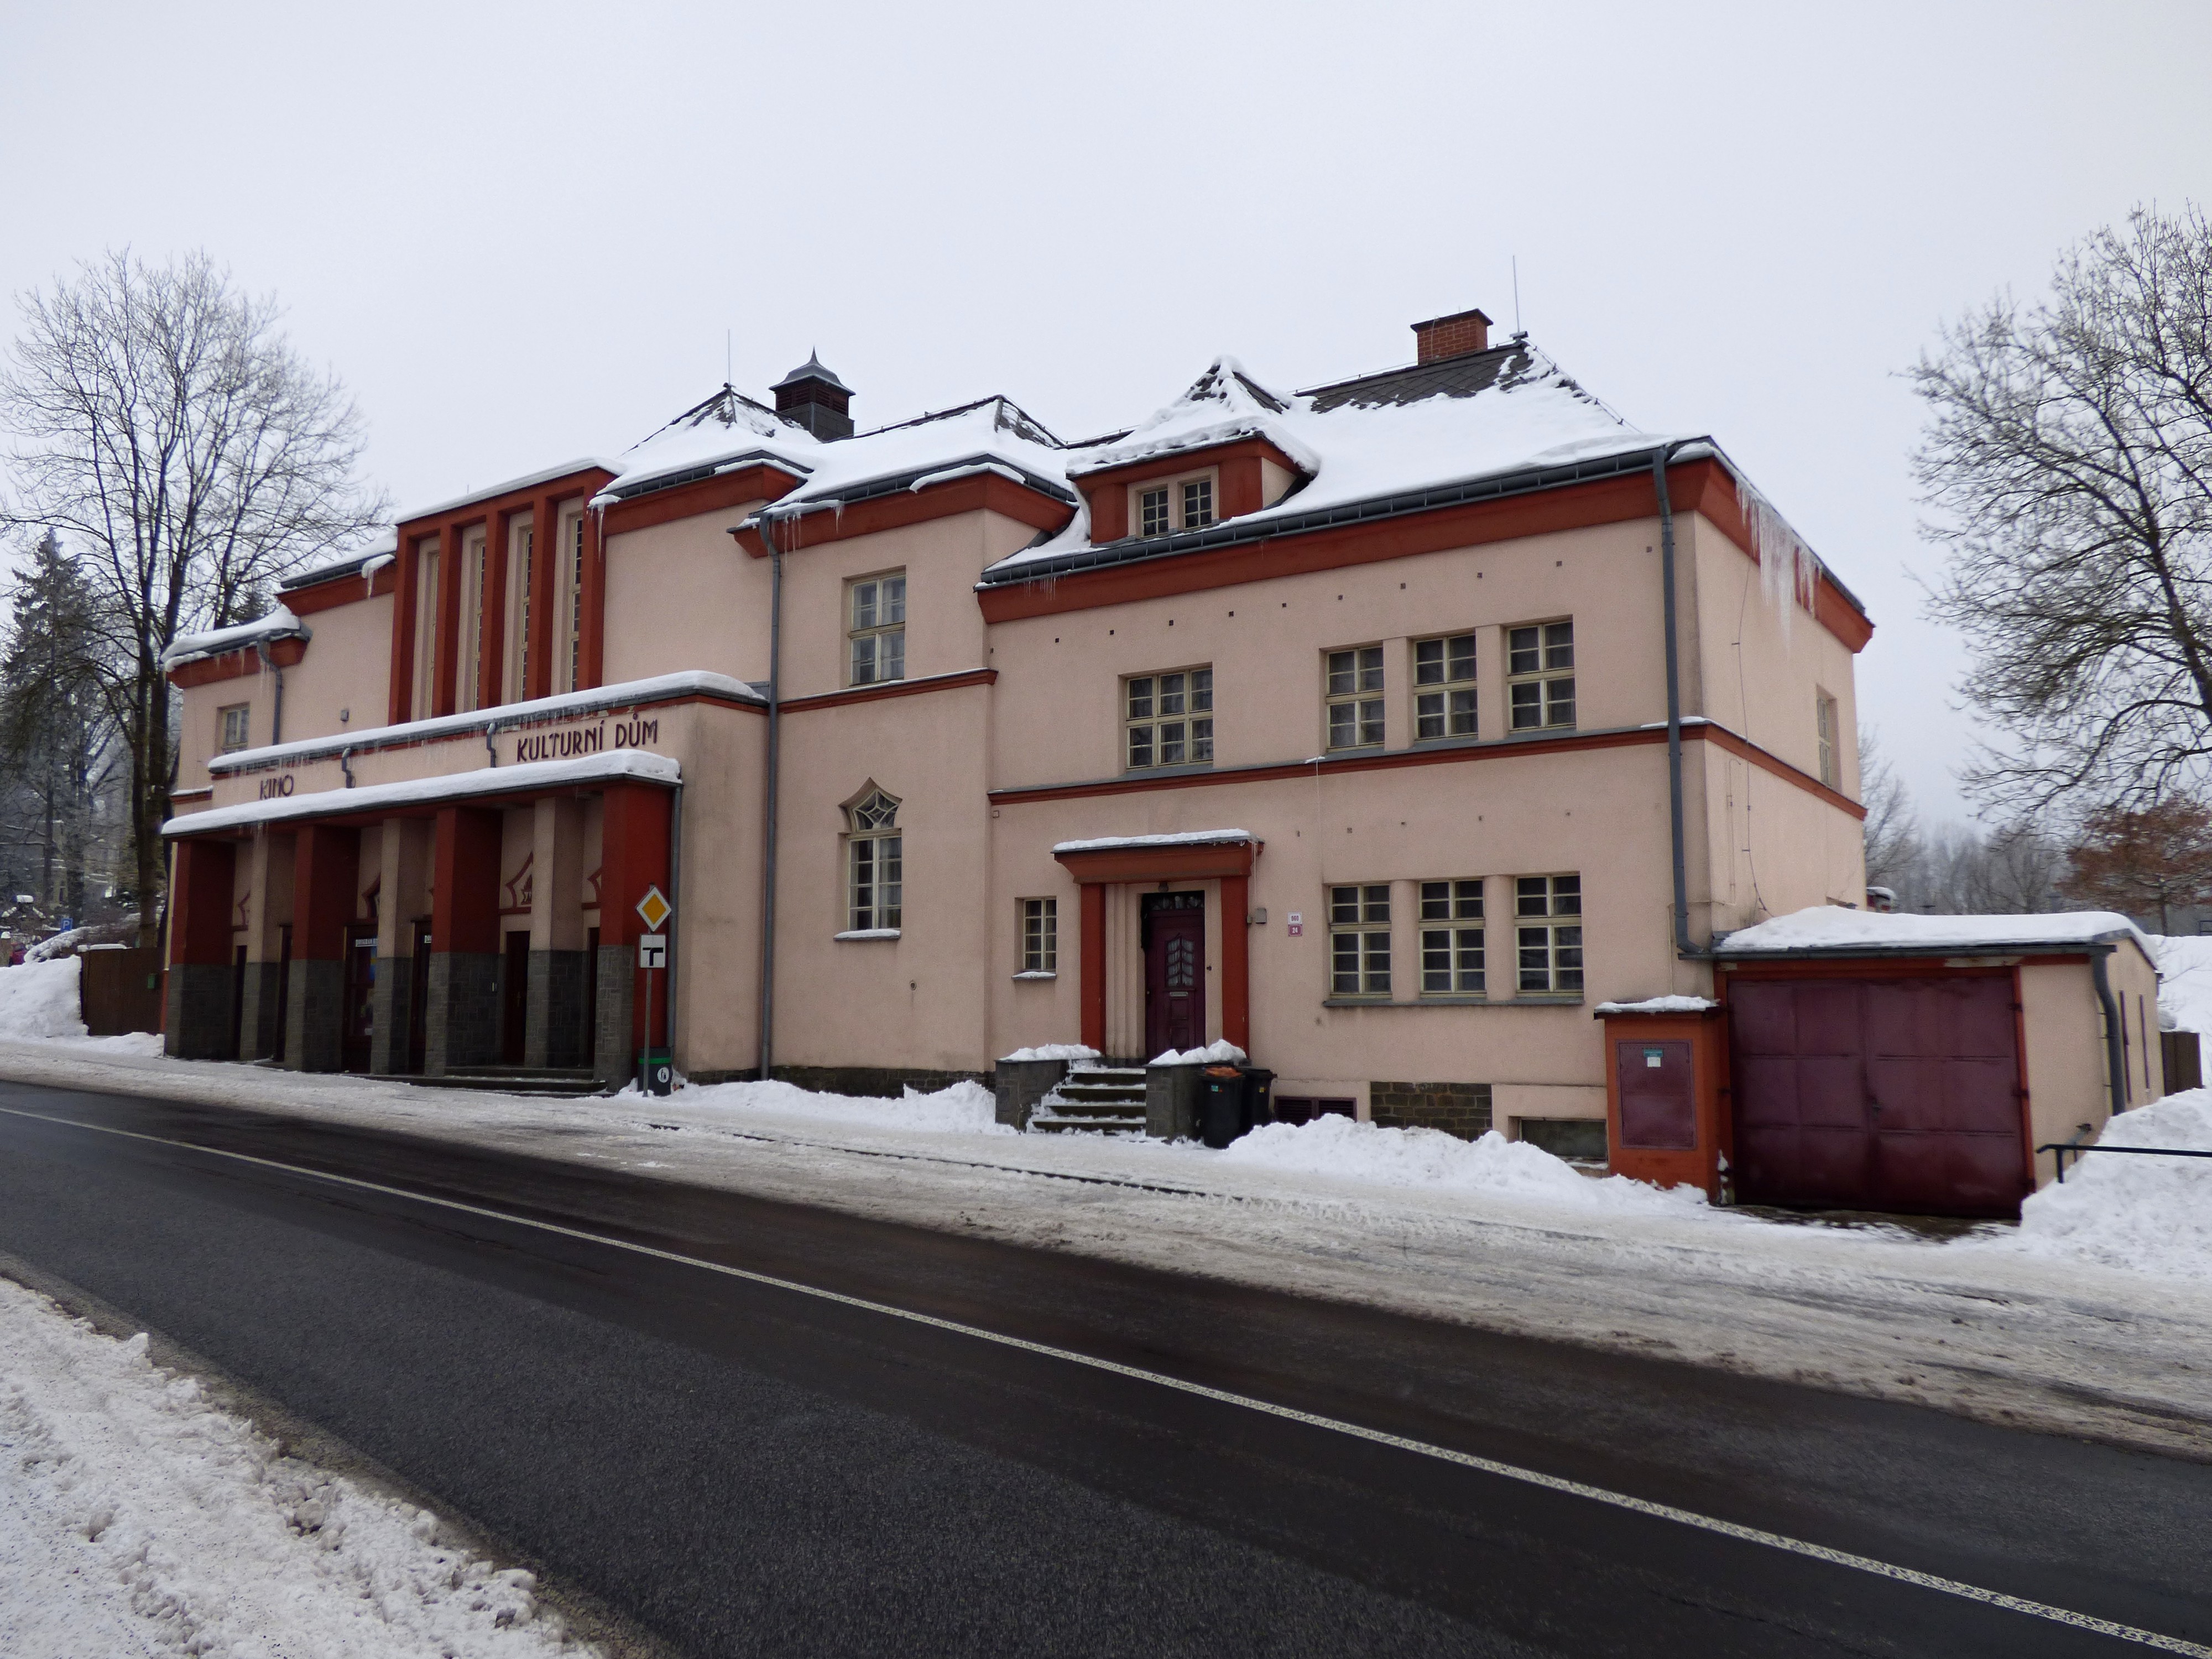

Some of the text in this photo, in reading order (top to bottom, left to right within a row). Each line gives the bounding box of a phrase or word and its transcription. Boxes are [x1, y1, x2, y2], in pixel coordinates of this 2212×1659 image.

[517, 712, 657, 762] KULTURNÍ DŮM
[260, 775, 294, 800] KINO
[62, 920, 70, 929] P
